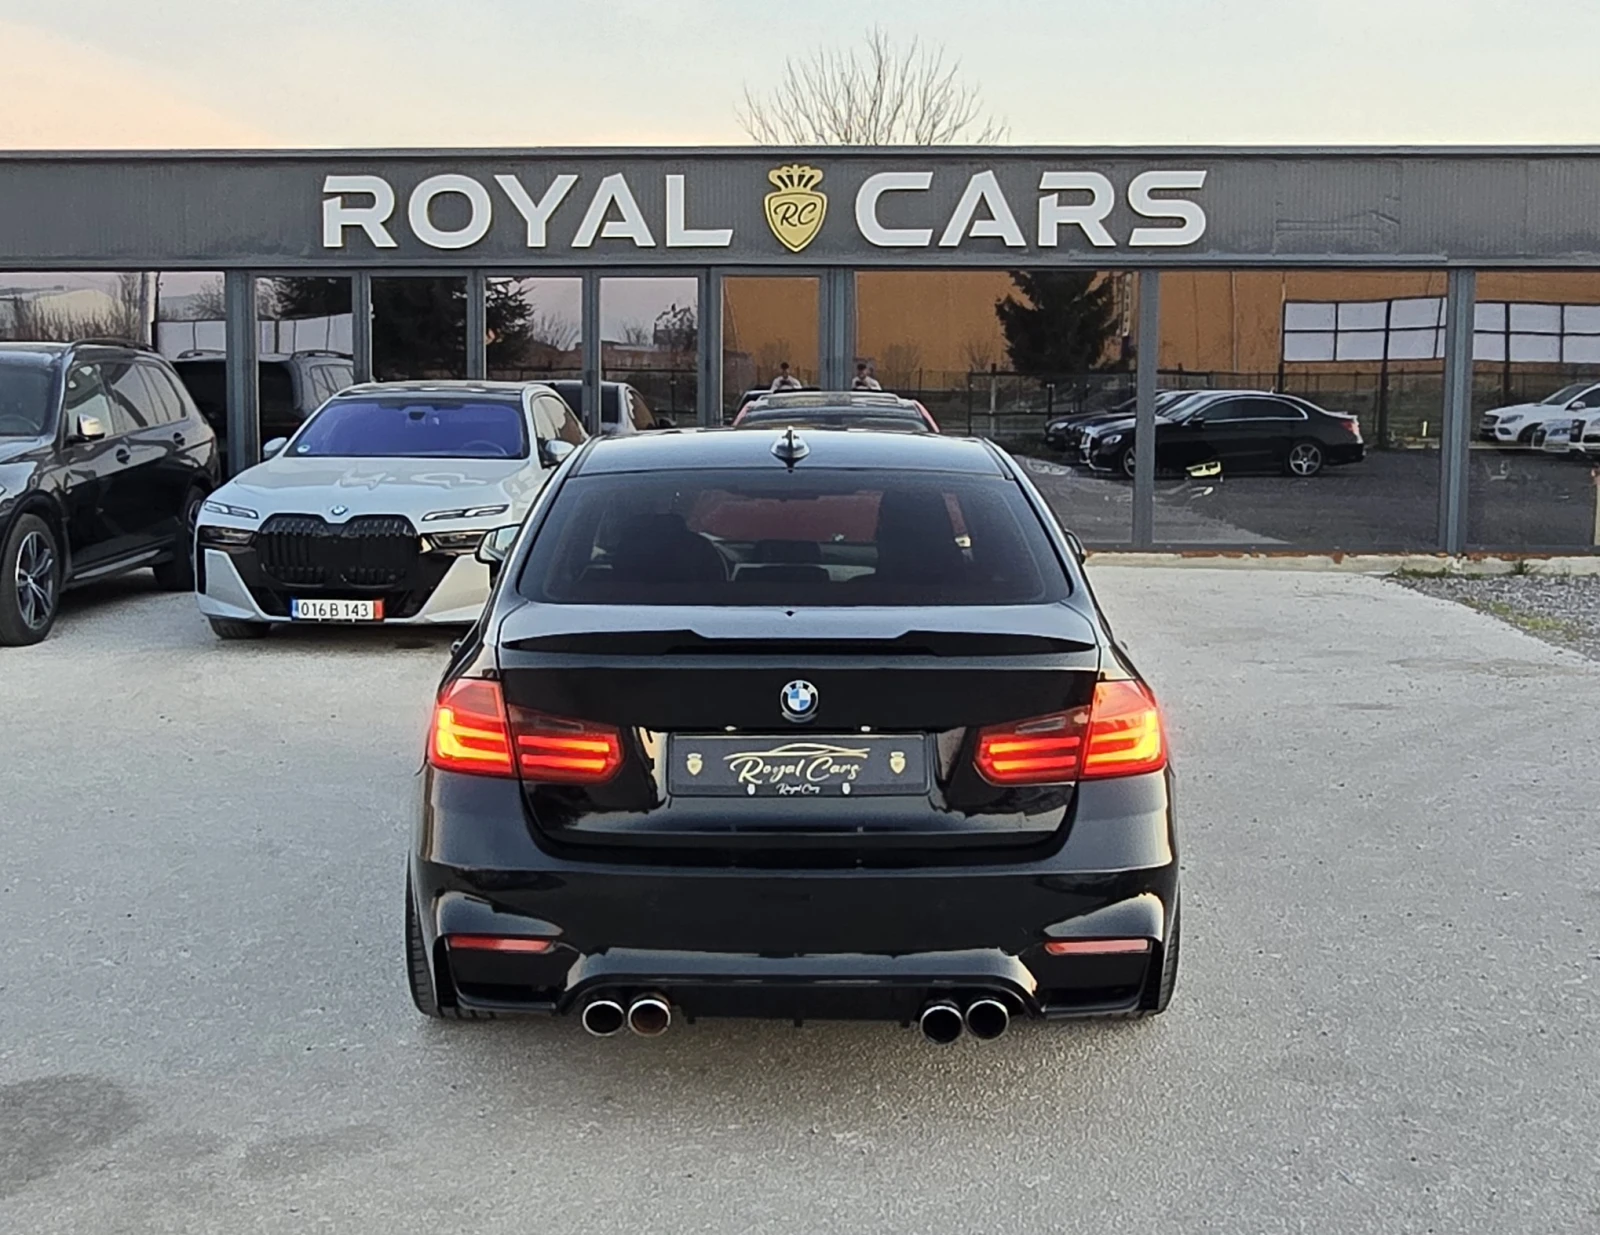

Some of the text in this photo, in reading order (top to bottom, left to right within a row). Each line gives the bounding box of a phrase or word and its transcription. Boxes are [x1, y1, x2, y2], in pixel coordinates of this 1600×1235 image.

[323, 170, 1207, 249] ROYAL CARS
[773, 201, 818, 228] RC
[344, 603, 369, 618] 143
[729, 756, 862, 784] Royal Cars
